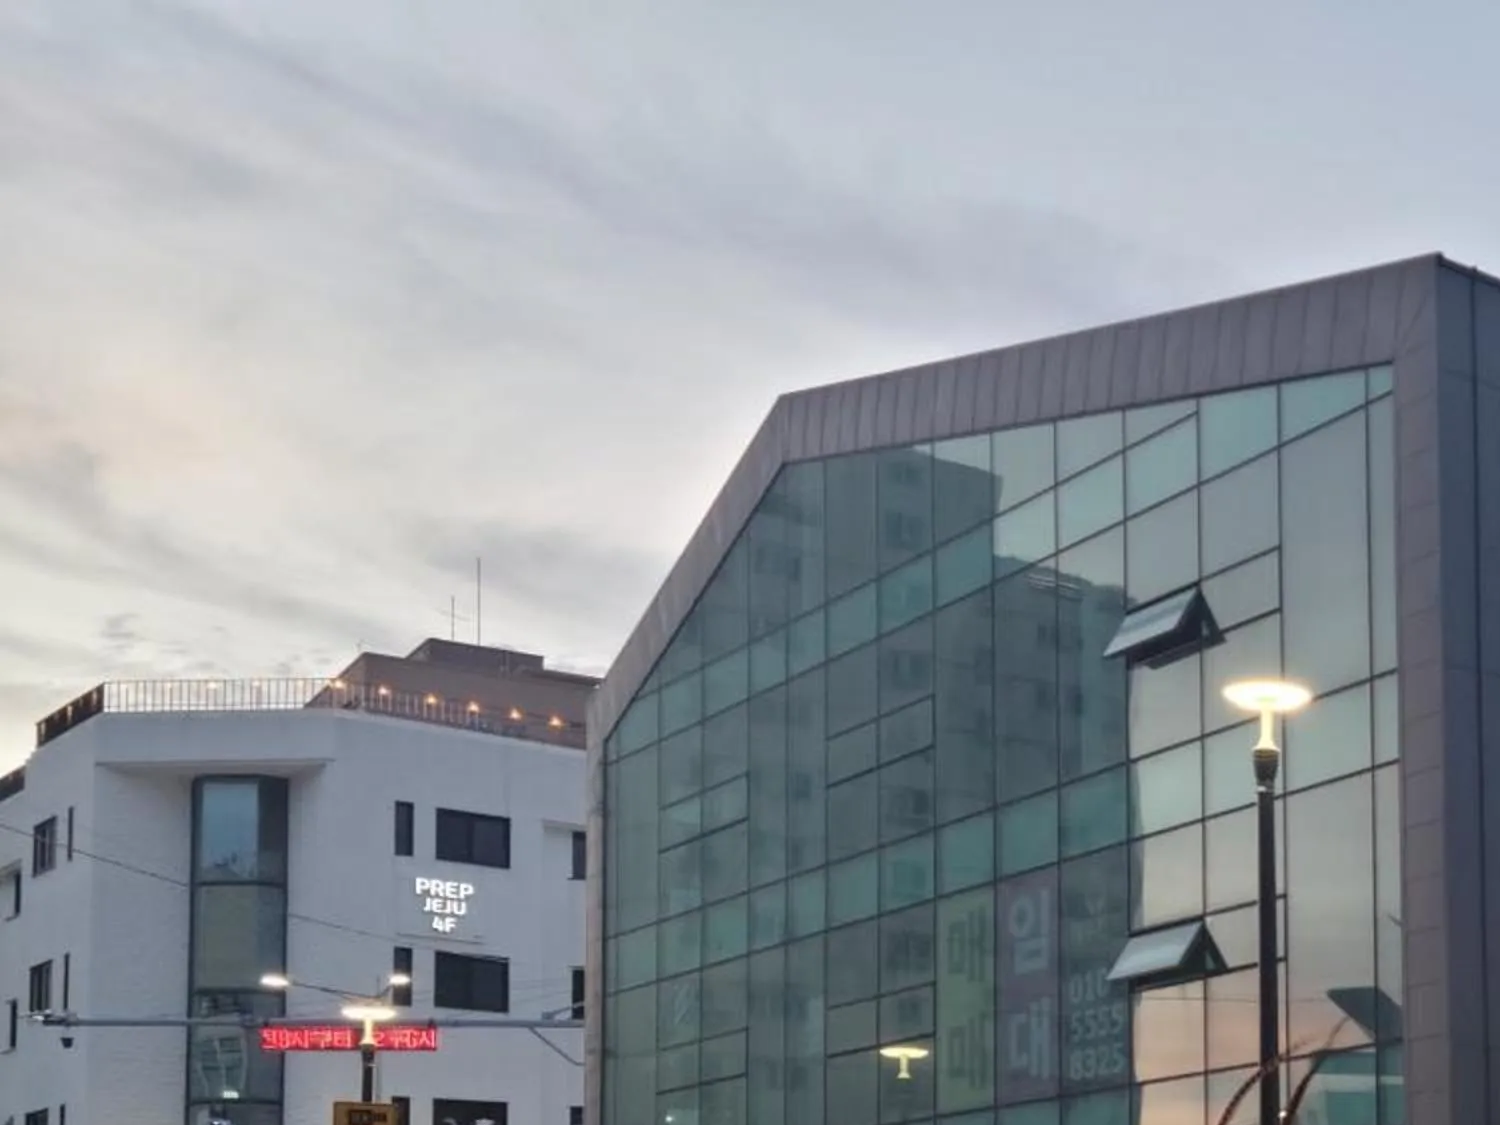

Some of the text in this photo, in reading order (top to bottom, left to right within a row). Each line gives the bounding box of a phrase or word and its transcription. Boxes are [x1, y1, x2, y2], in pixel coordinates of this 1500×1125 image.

[415, 877, 474, 898] PREP
[423, 897, 466, 915] JEJU
[431, 916, 457, 933] 4F
[1008, 889, 1050, 1080] 임대
